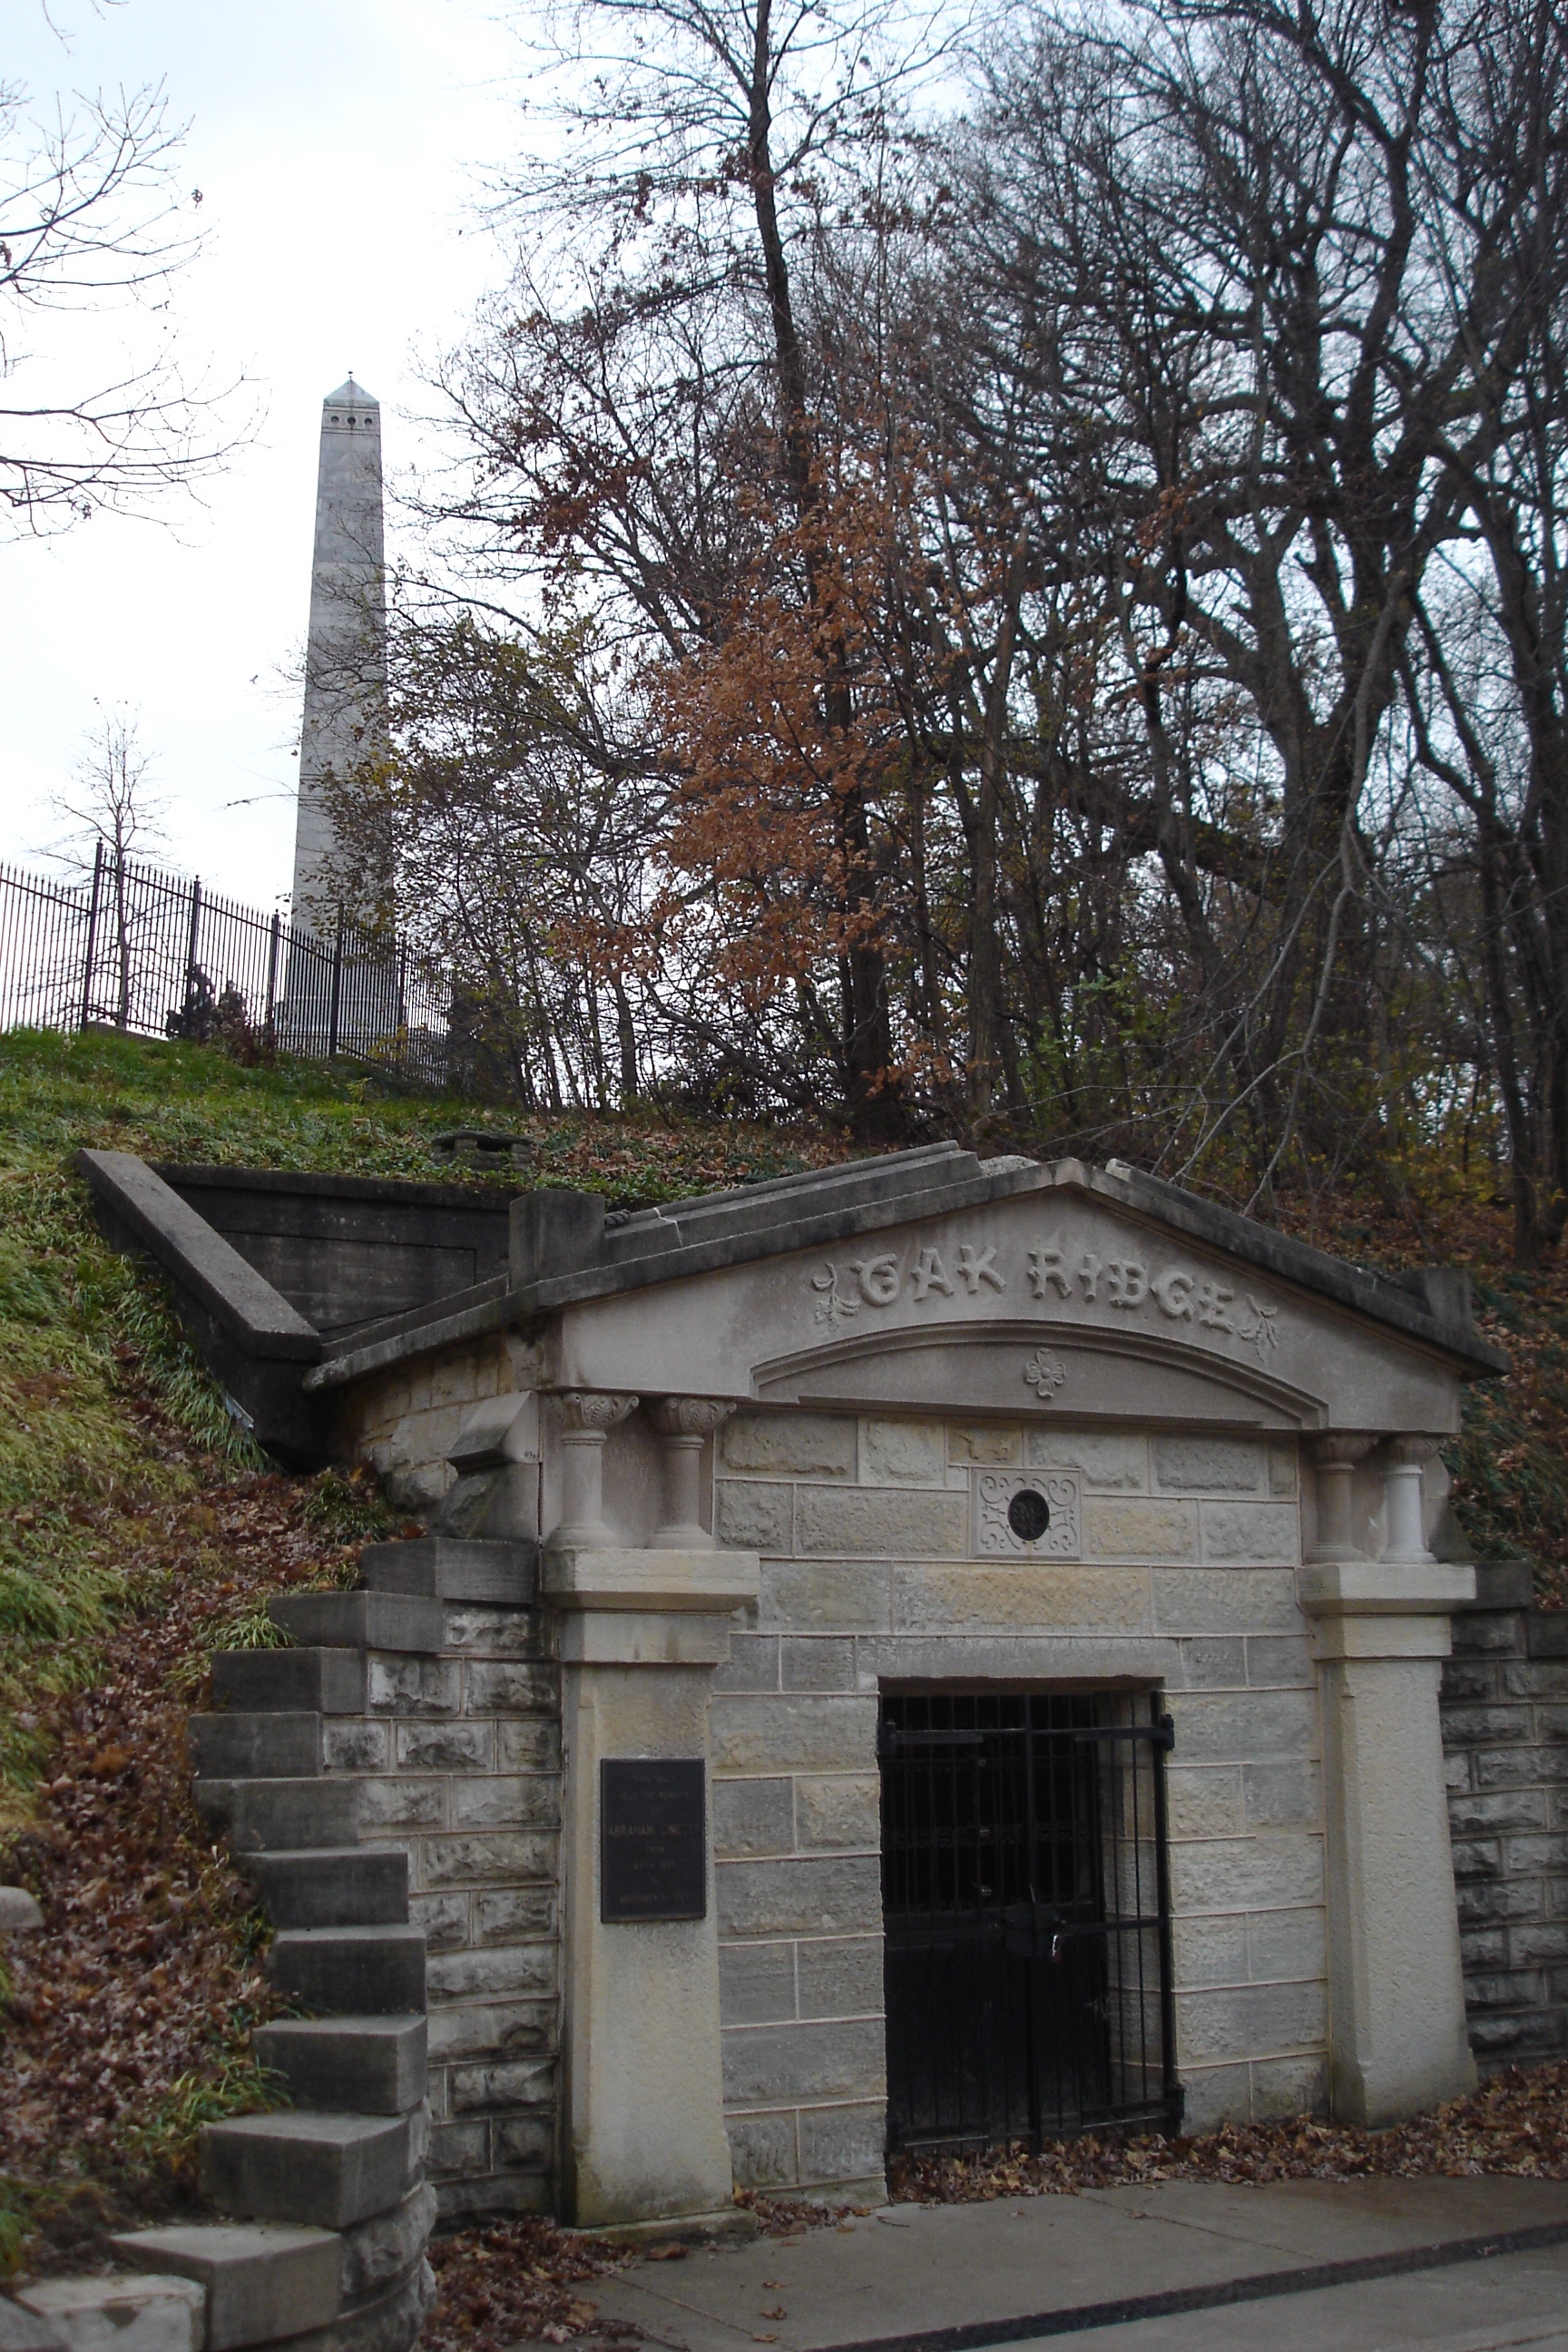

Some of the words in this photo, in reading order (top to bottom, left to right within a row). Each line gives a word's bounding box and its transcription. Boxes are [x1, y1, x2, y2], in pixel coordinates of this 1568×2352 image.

[849, 1243, 1007, 1307] OAK
[1026, 1244, 1235, 1335] RIDGE
[608, 1825, 655, 1837] ABRAHAM
